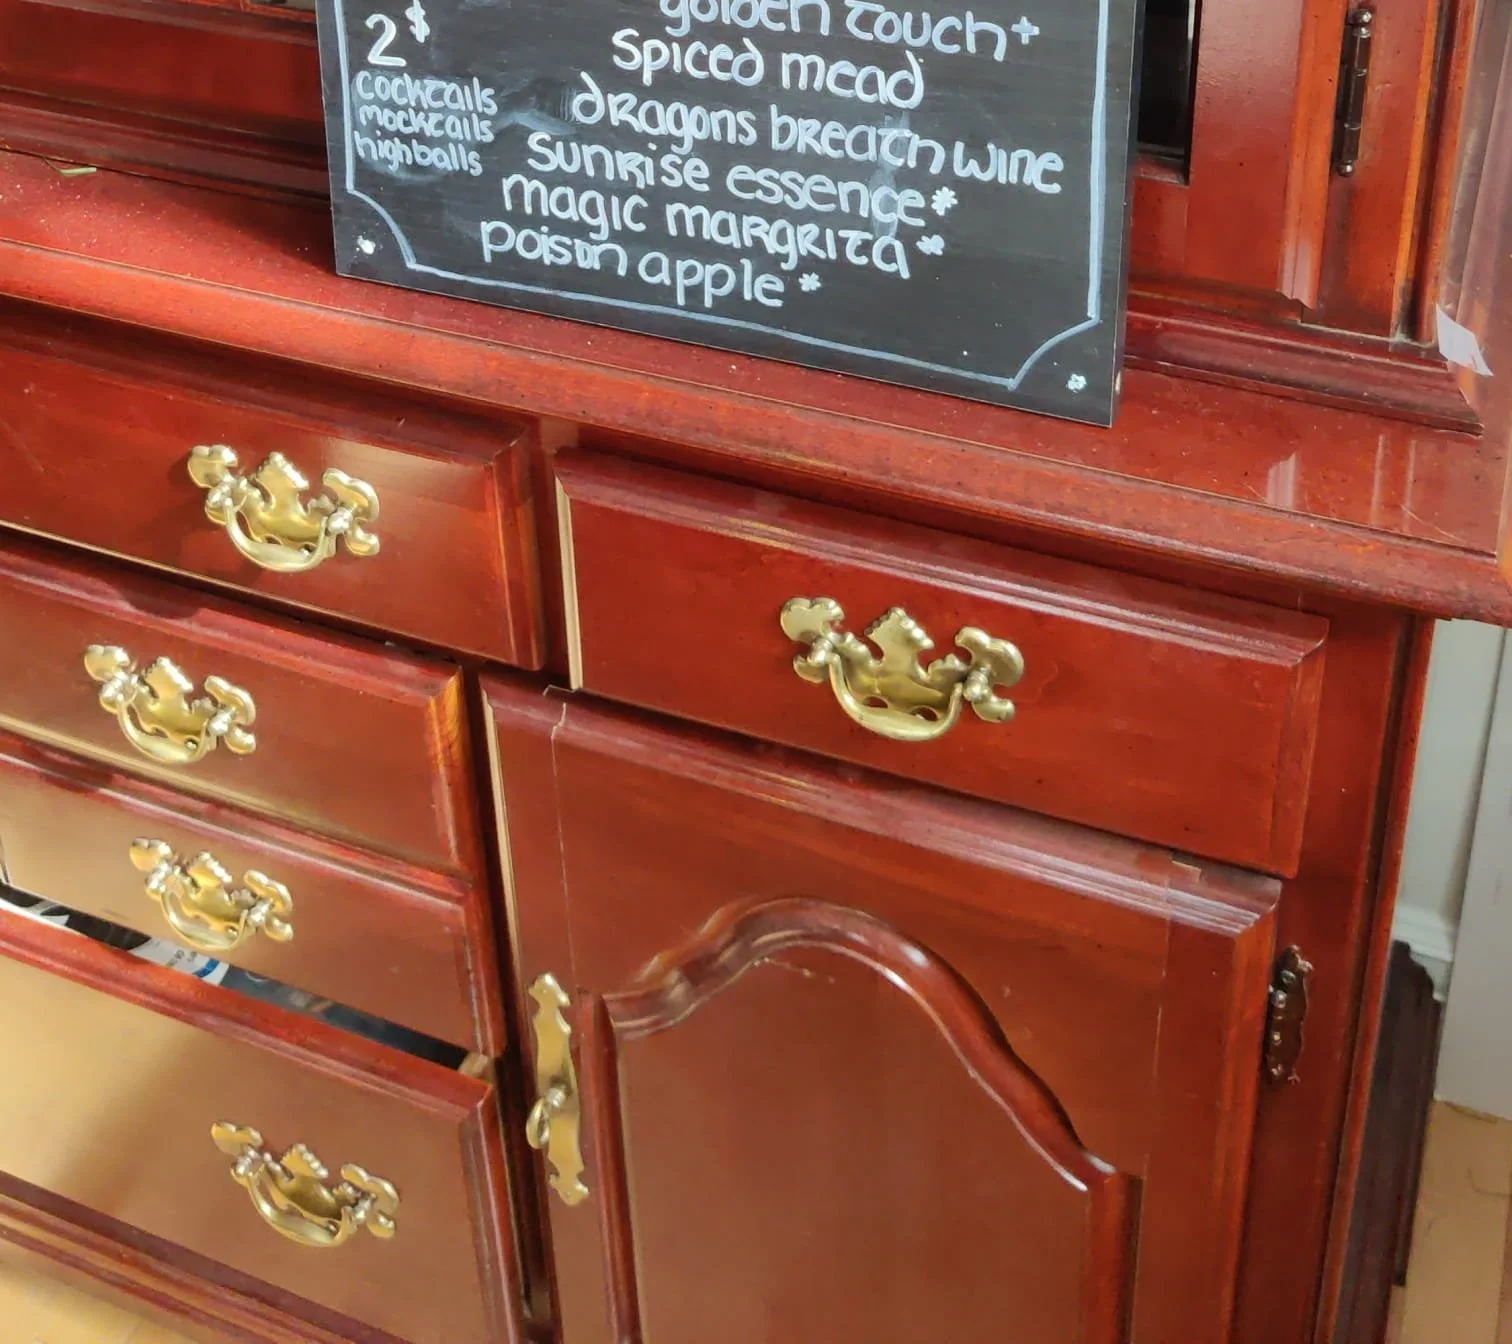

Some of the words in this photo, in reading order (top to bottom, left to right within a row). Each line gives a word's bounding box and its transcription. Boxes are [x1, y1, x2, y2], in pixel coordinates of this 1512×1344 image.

[365, 0, 431, 67] 2$
[782, 51, 924, 109] mead
[354, 130, 483, 176] highballs
[953, 141, 1064, 194] wine
[503, 174, 648, 241] magic
